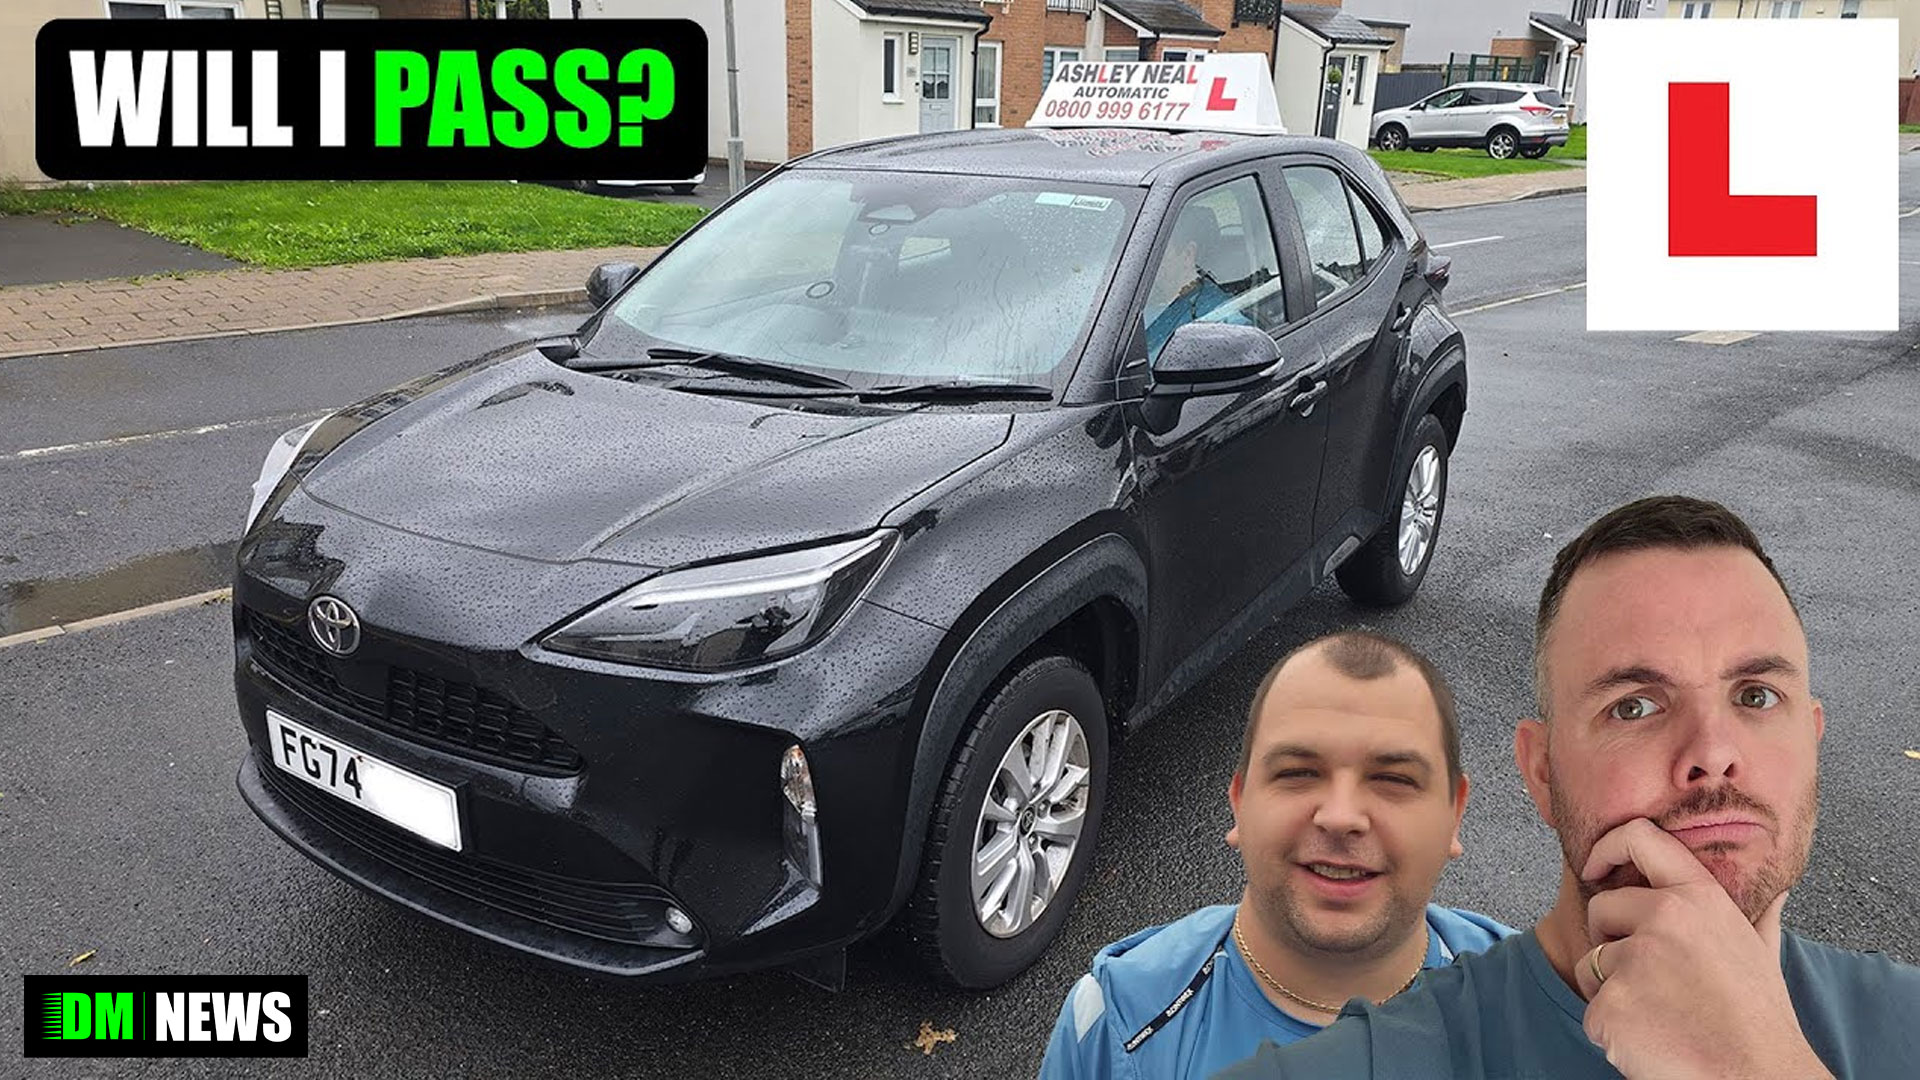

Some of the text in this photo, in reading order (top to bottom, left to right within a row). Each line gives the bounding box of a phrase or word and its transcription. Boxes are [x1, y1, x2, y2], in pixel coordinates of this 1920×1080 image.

[1055, 64, 1198, 84] ASHLEY NEAL
[1073, 86, 1169, 99] AUTOMATIC
[1206, 77, 1238, 111] L
[1045, 99, 1190, 121] 0800 999 6177
[280, 724, 362, 800] FG74
